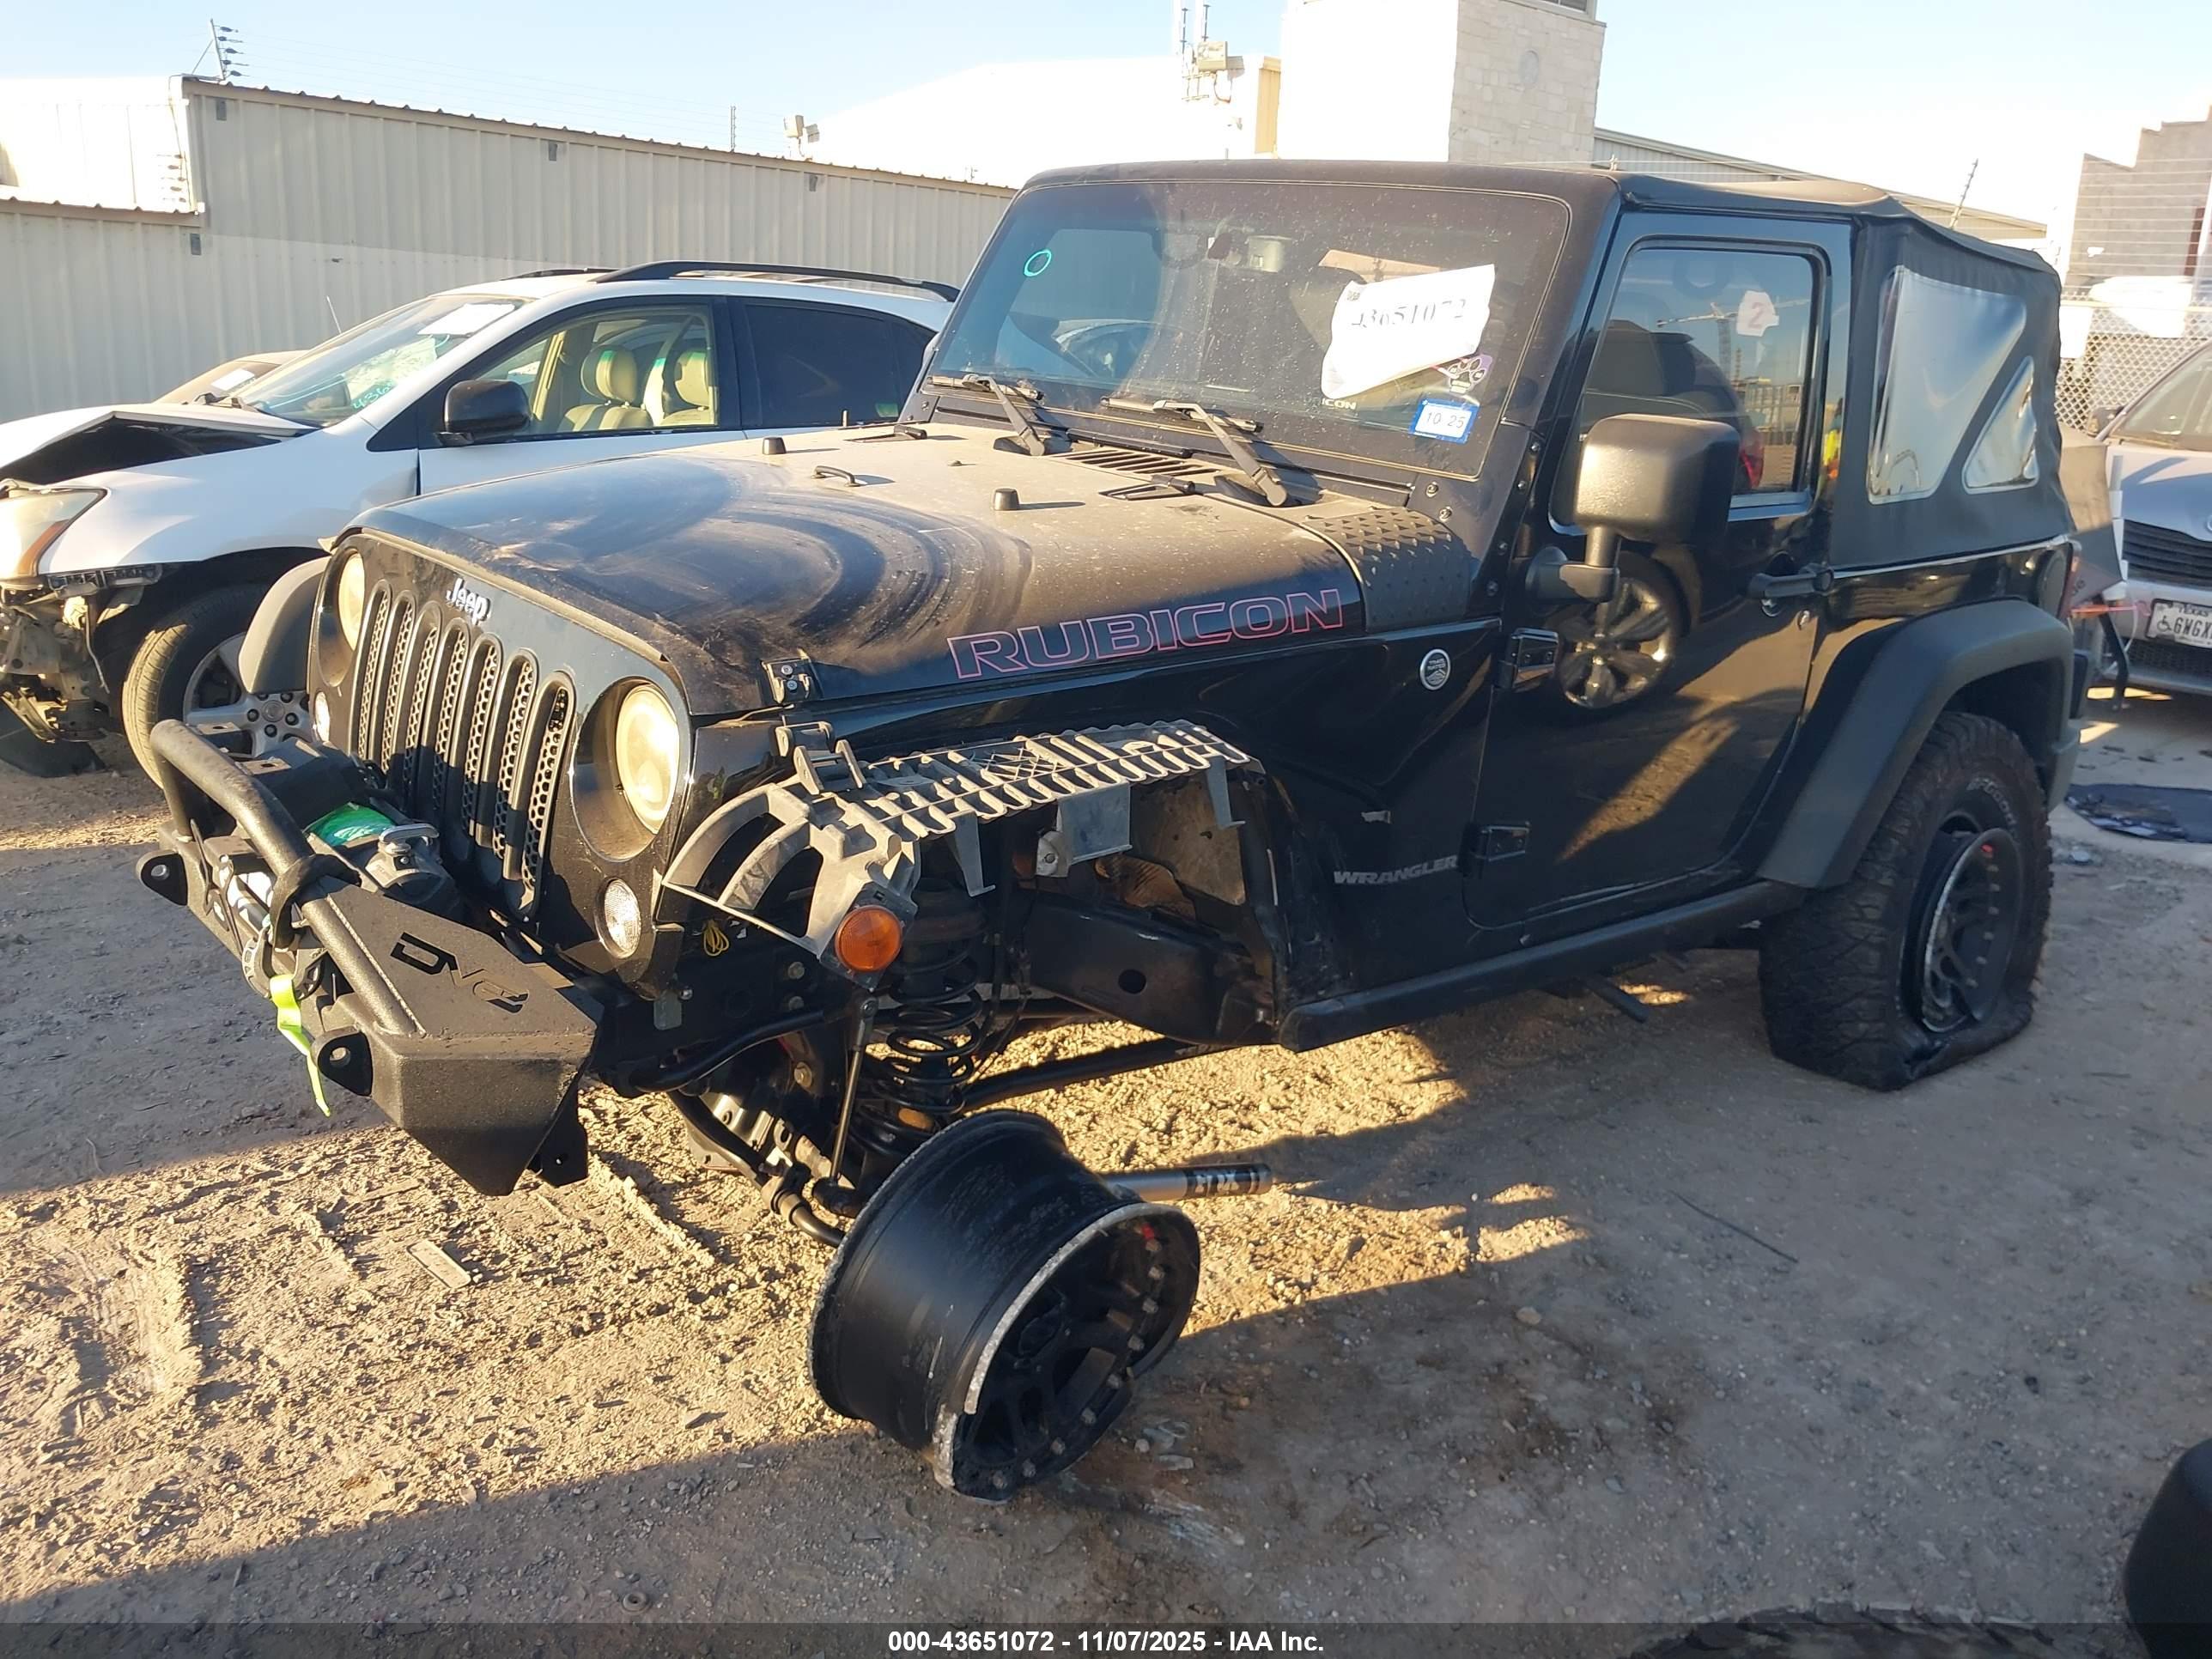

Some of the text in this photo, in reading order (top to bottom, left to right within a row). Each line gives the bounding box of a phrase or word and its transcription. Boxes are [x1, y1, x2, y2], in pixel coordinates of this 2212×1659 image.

[1426, 411, 1466, 428] 10 25
[446, 578, 489, 626] Jeep
[947, 589, 1344, 679] RUBICON
[2173, 617, 2212, 641] 6WGX
[1334, 854, 1458, 885] WRANGLER
